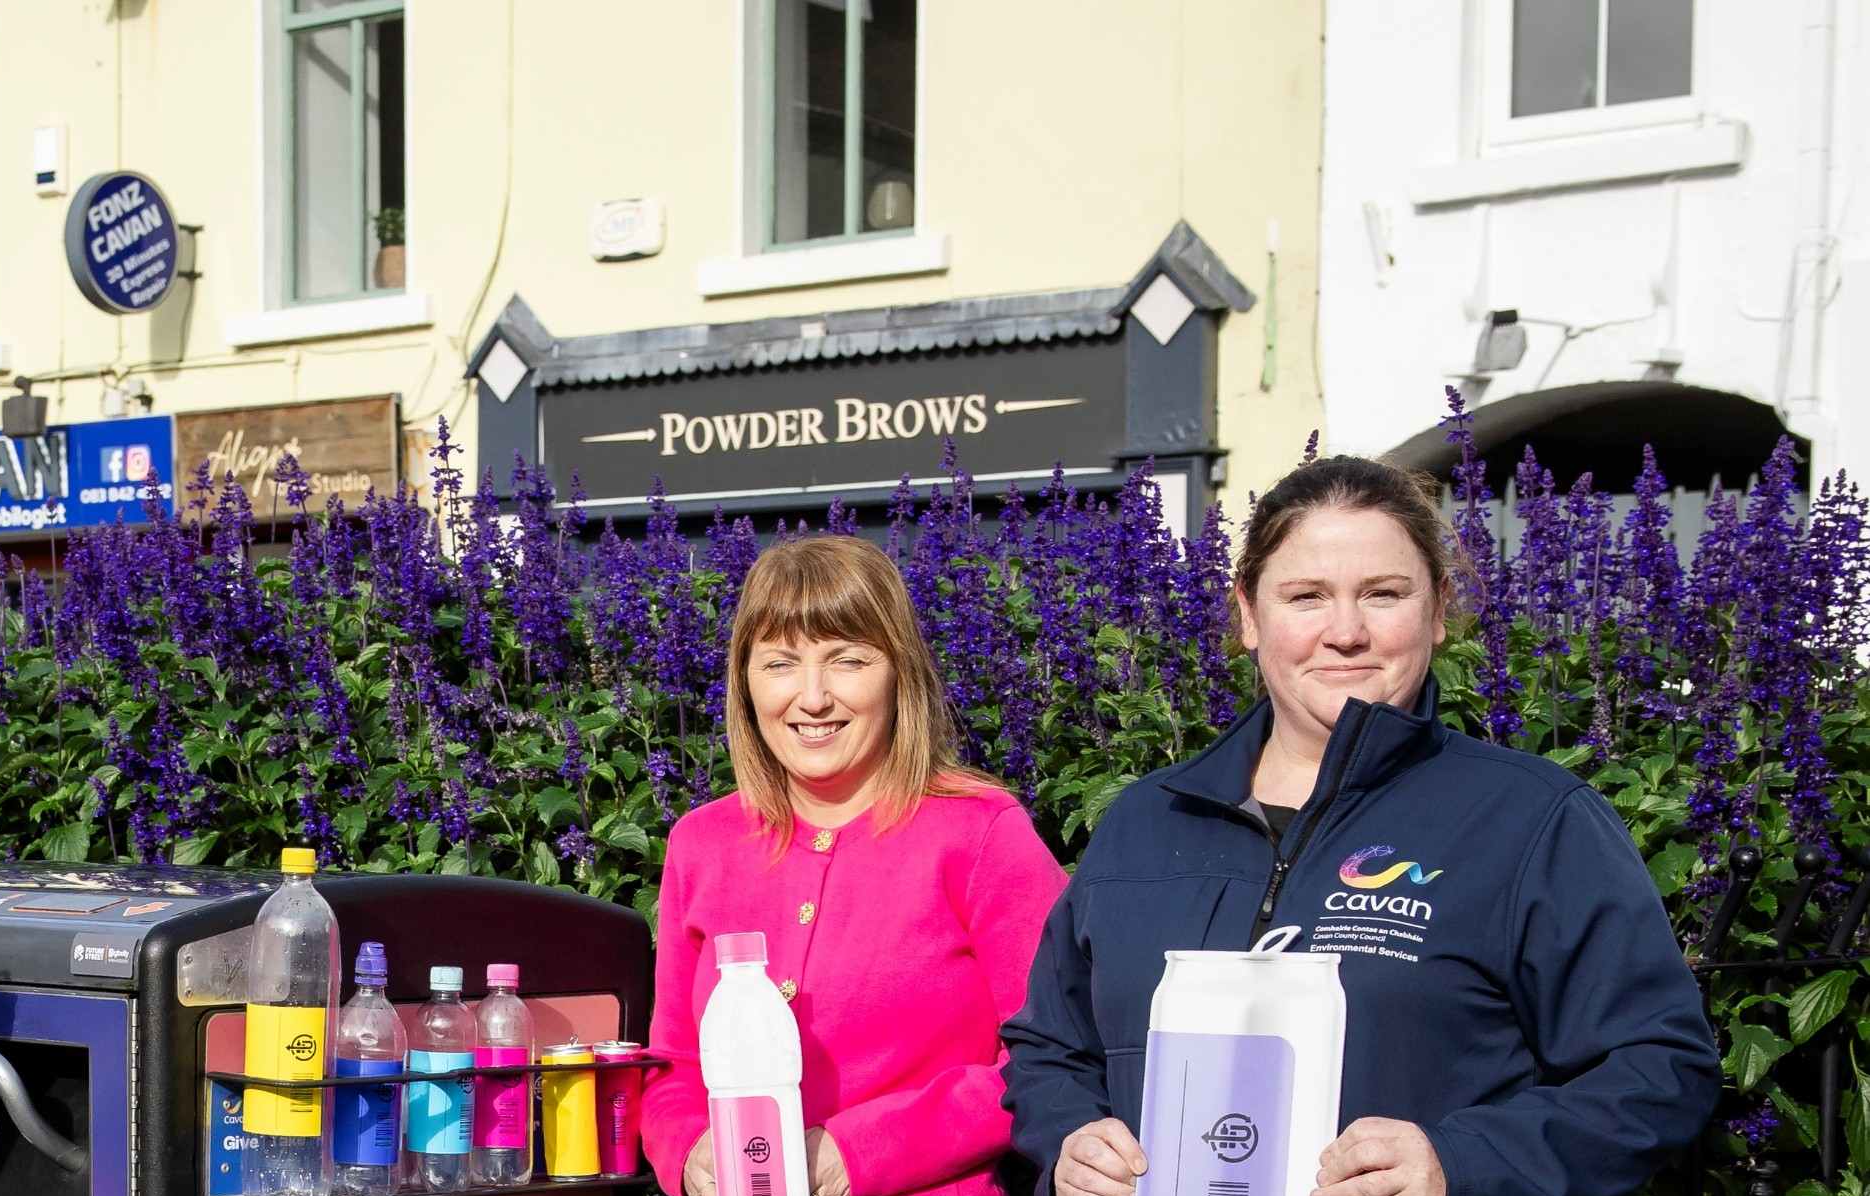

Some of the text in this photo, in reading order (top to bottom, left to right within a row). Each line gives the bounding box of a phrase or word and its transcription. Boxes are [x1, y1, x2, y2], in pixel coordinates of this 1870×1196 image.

[88, 181, 145, 232] FONZ
[91, 204, 163, 263] CAVAN
[123, 239, 170, 273] Minutes
[660, 394, 987, 456] POWDER BROWS
[312, 470, 371, 495] Studio
[1310, 943, 1419, 962] Environmental Services
[223, 1135, 259, 1151] Give
